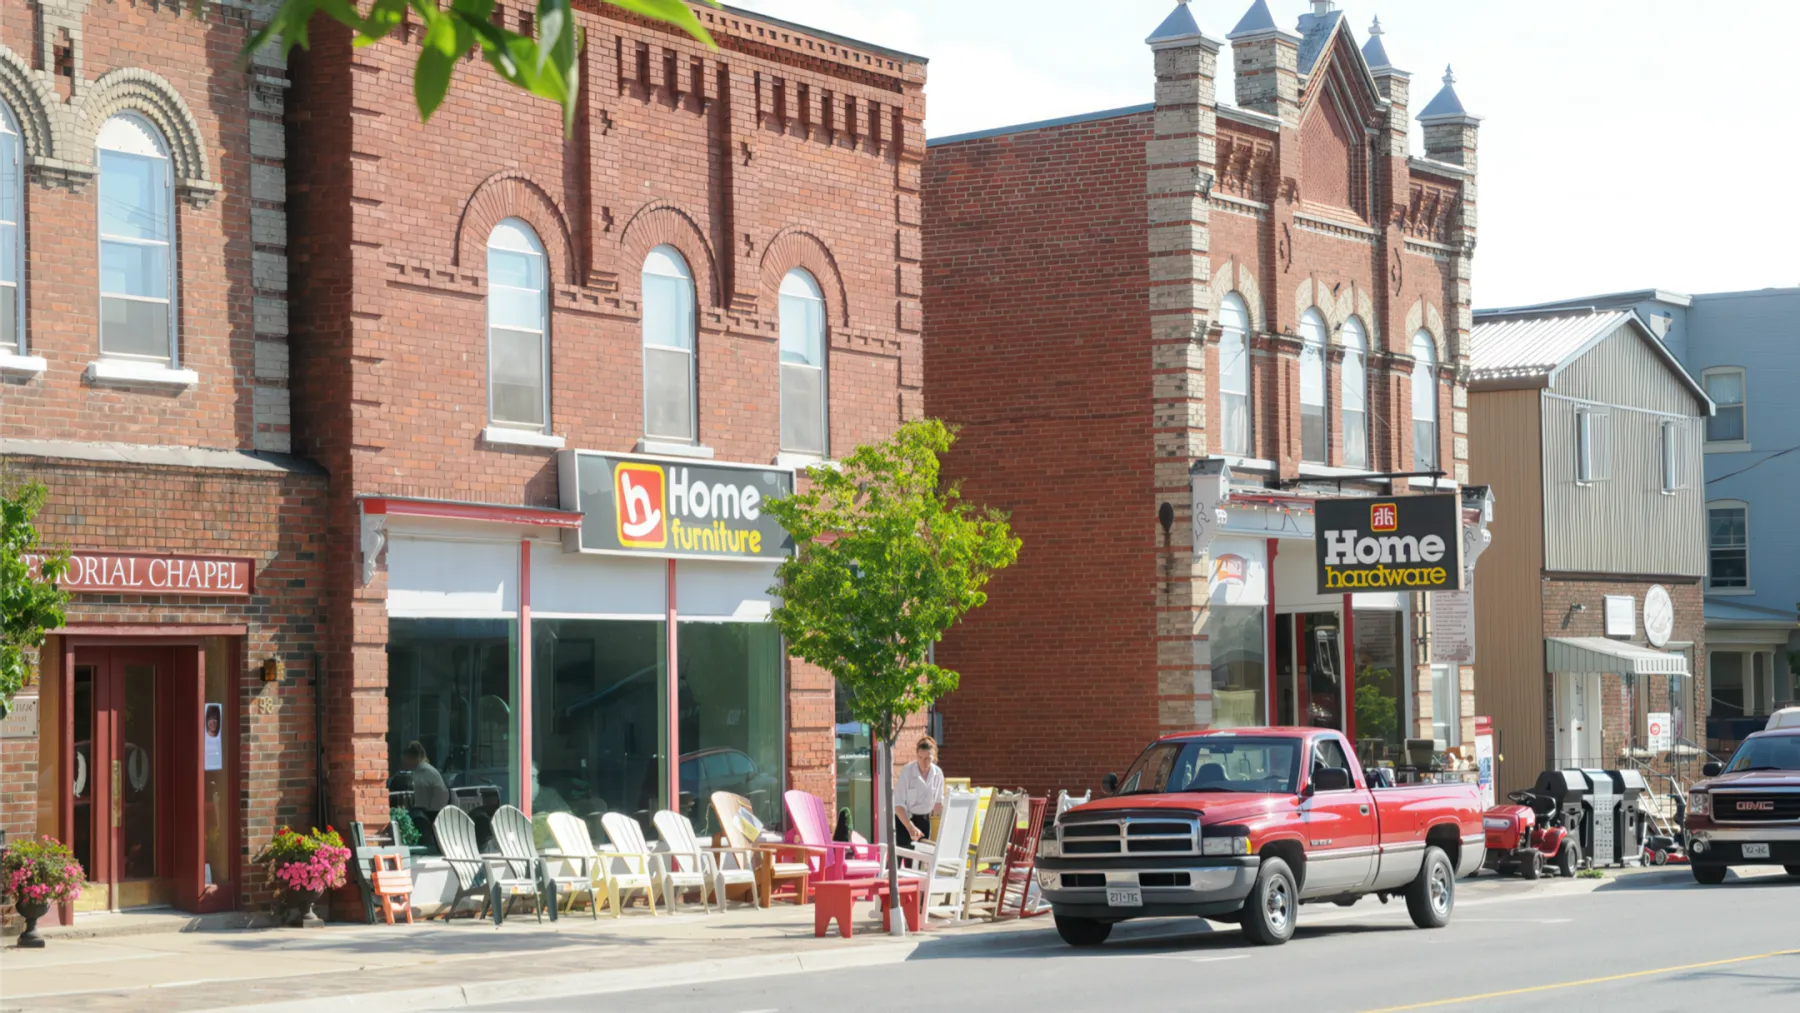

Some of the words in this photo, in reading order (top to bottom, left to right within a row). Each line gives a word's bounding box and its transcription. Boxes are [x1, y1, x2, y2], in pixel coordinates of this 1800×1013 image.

[669, 467, 760, 520] Home
[672, 519, 761, 553] furniture
[1324, 529, 1446, 566] Home
[149, 558, 243, 590] CHAPEL
[1325, 564, 1447, 588] hardware
[1736, 801, 1774, 811] GMC
